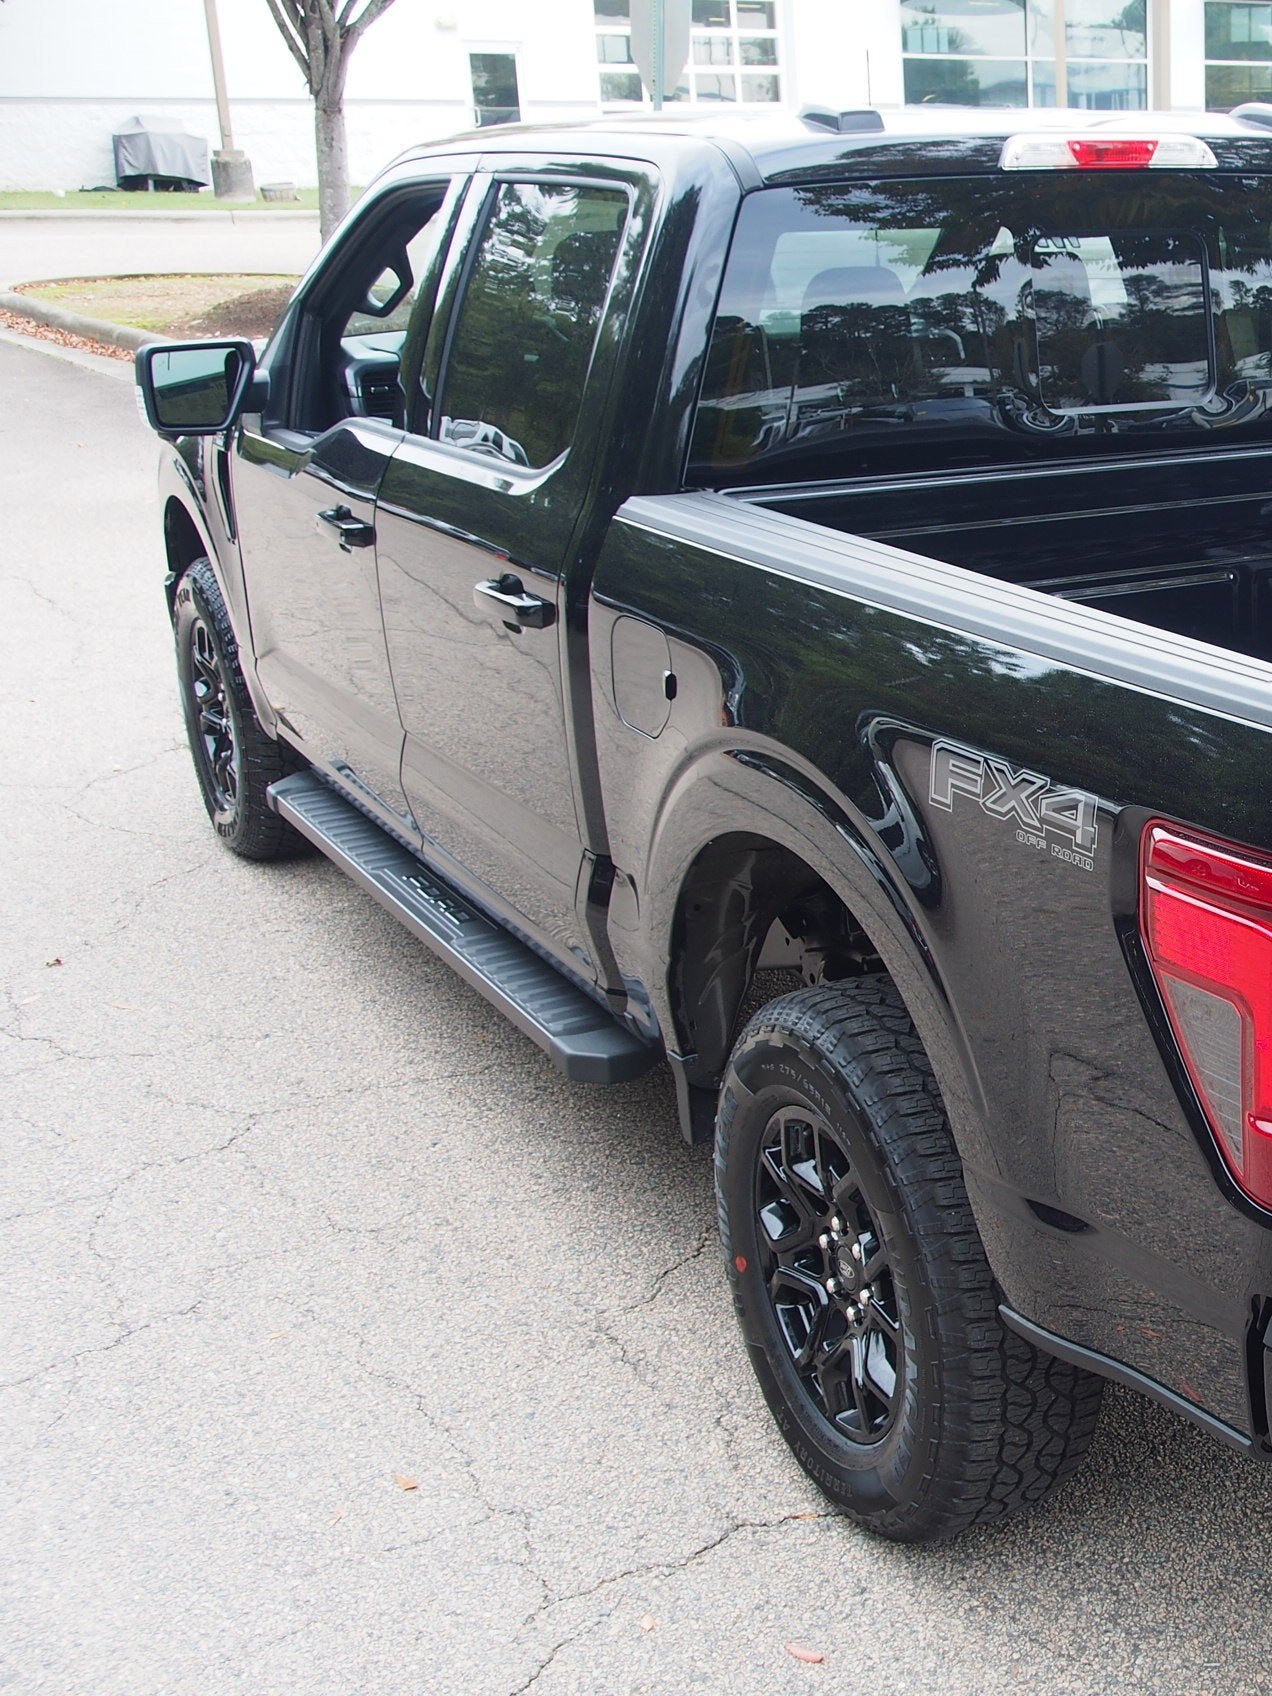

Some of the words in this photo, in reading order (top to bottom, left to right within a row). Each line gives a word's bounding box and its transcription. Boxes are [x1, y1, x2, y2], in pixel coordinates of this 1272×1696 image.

[929, 738, 1099, 857] FX4
[1015, 829, 1047, 850] OFF
[1051, 843, 1094, 872] ROAD
[794, 1440, 853, 1498] TERRITORY
